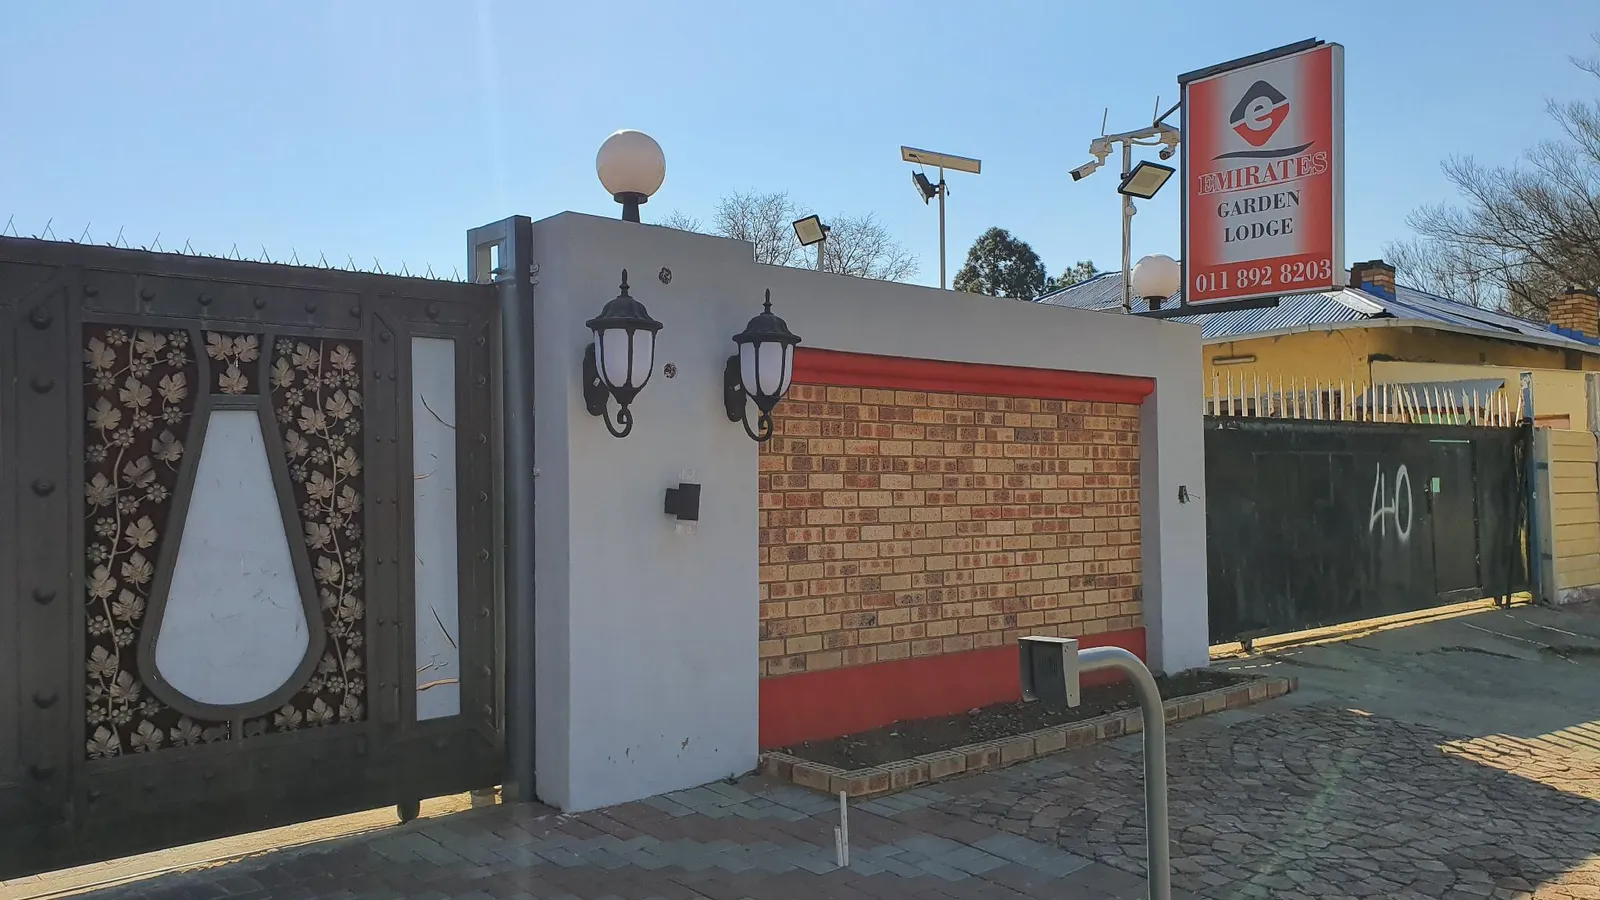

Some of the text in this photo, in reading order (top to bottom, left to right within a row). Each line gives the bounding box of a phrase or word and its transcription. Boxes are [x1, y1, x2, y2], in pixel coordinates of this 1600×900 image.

[1198, 151, 1328, 195] EMIRATES
[1217, 189, 1300, 218] GARDEN
[1224, 217, 1293, 243] LODGE
[1195, 258, 1332, 293] 011 892 8203
[1369, 462, 1413, 541] 40
